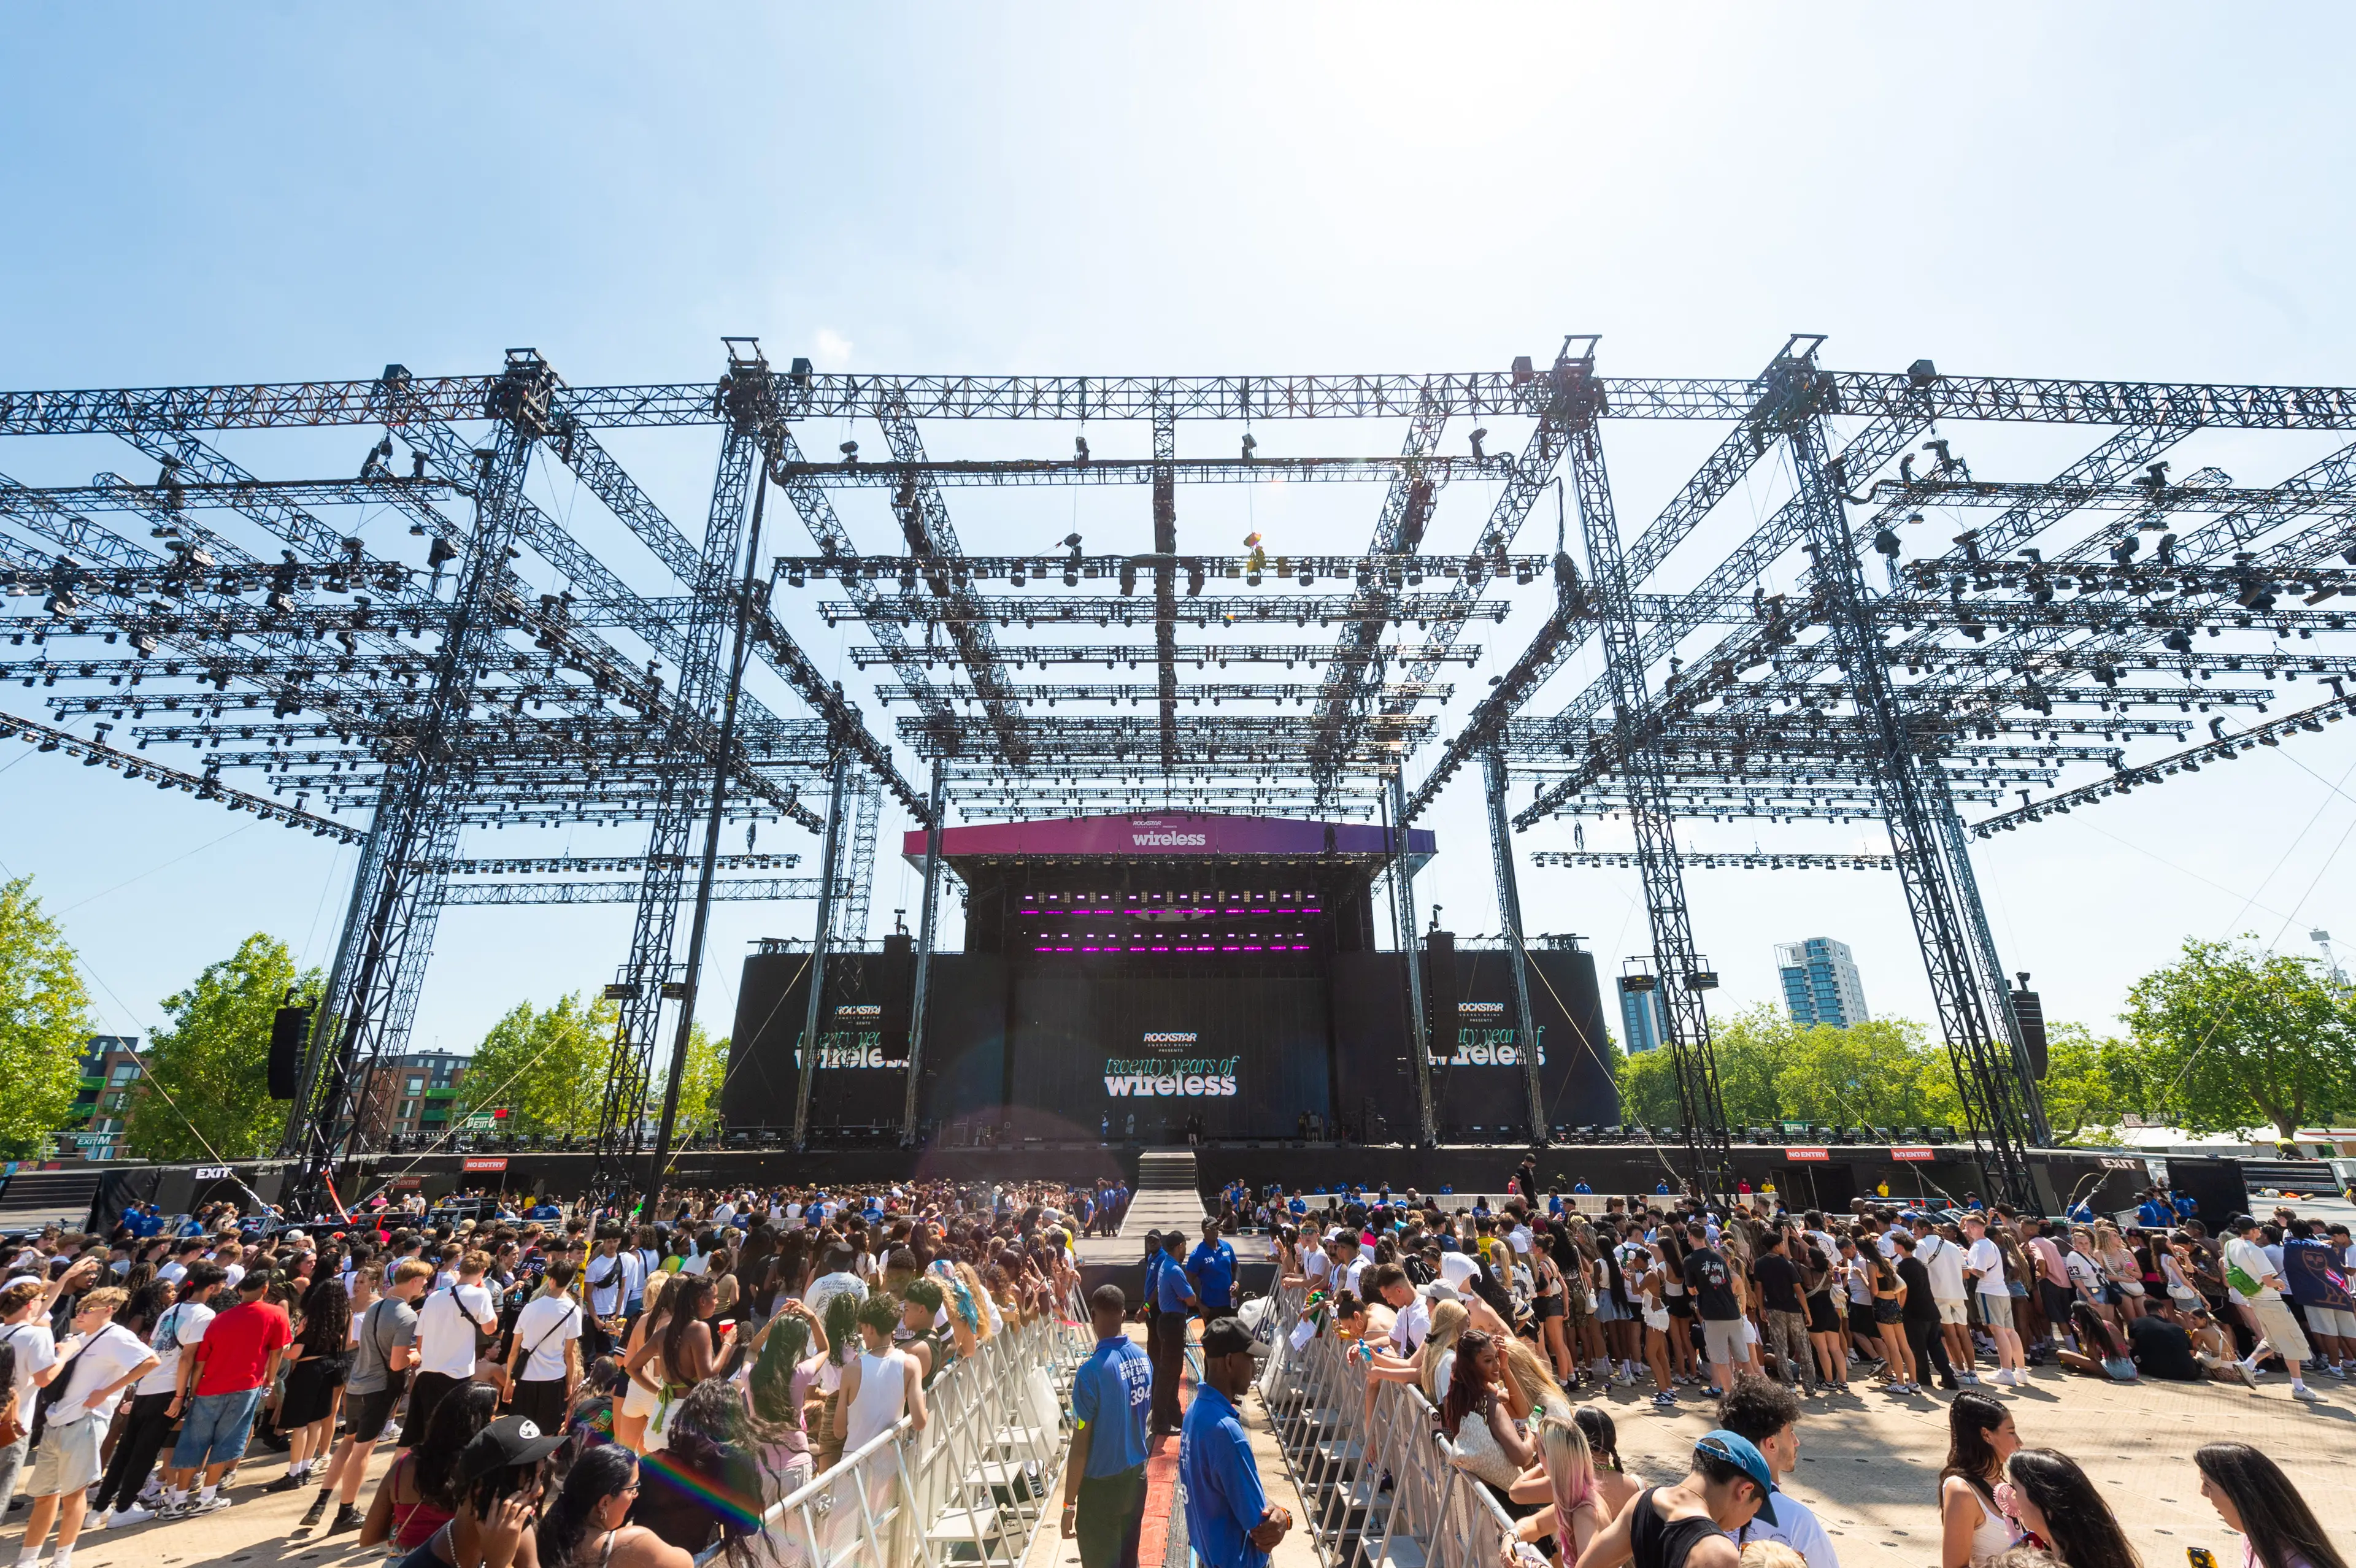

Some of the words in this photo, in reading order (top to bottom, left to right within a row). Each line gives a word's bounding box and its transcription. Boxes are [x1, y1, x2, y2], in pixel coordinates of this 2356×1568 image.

[1133, 831, 1206, 846] wireless
[1144, 1032, 1198, 1042] ROCKSTAR
[1105, 1057, 1167, 1078] twenty
[1166, 1058, 1215, 1078] years
[1219, 1055, 1240, 1078] of
[1104, 1070, 1237, 1096] wireless
[2100, 1158, 2136, 1169] EXIT
[195, 1167, 233, 1179] EXIT
[2068, 1266, 2080, 1275] 23
[1131, 1375, 1145, 1385] TEAM
[1131, 1385, 1151, 1406] 394
